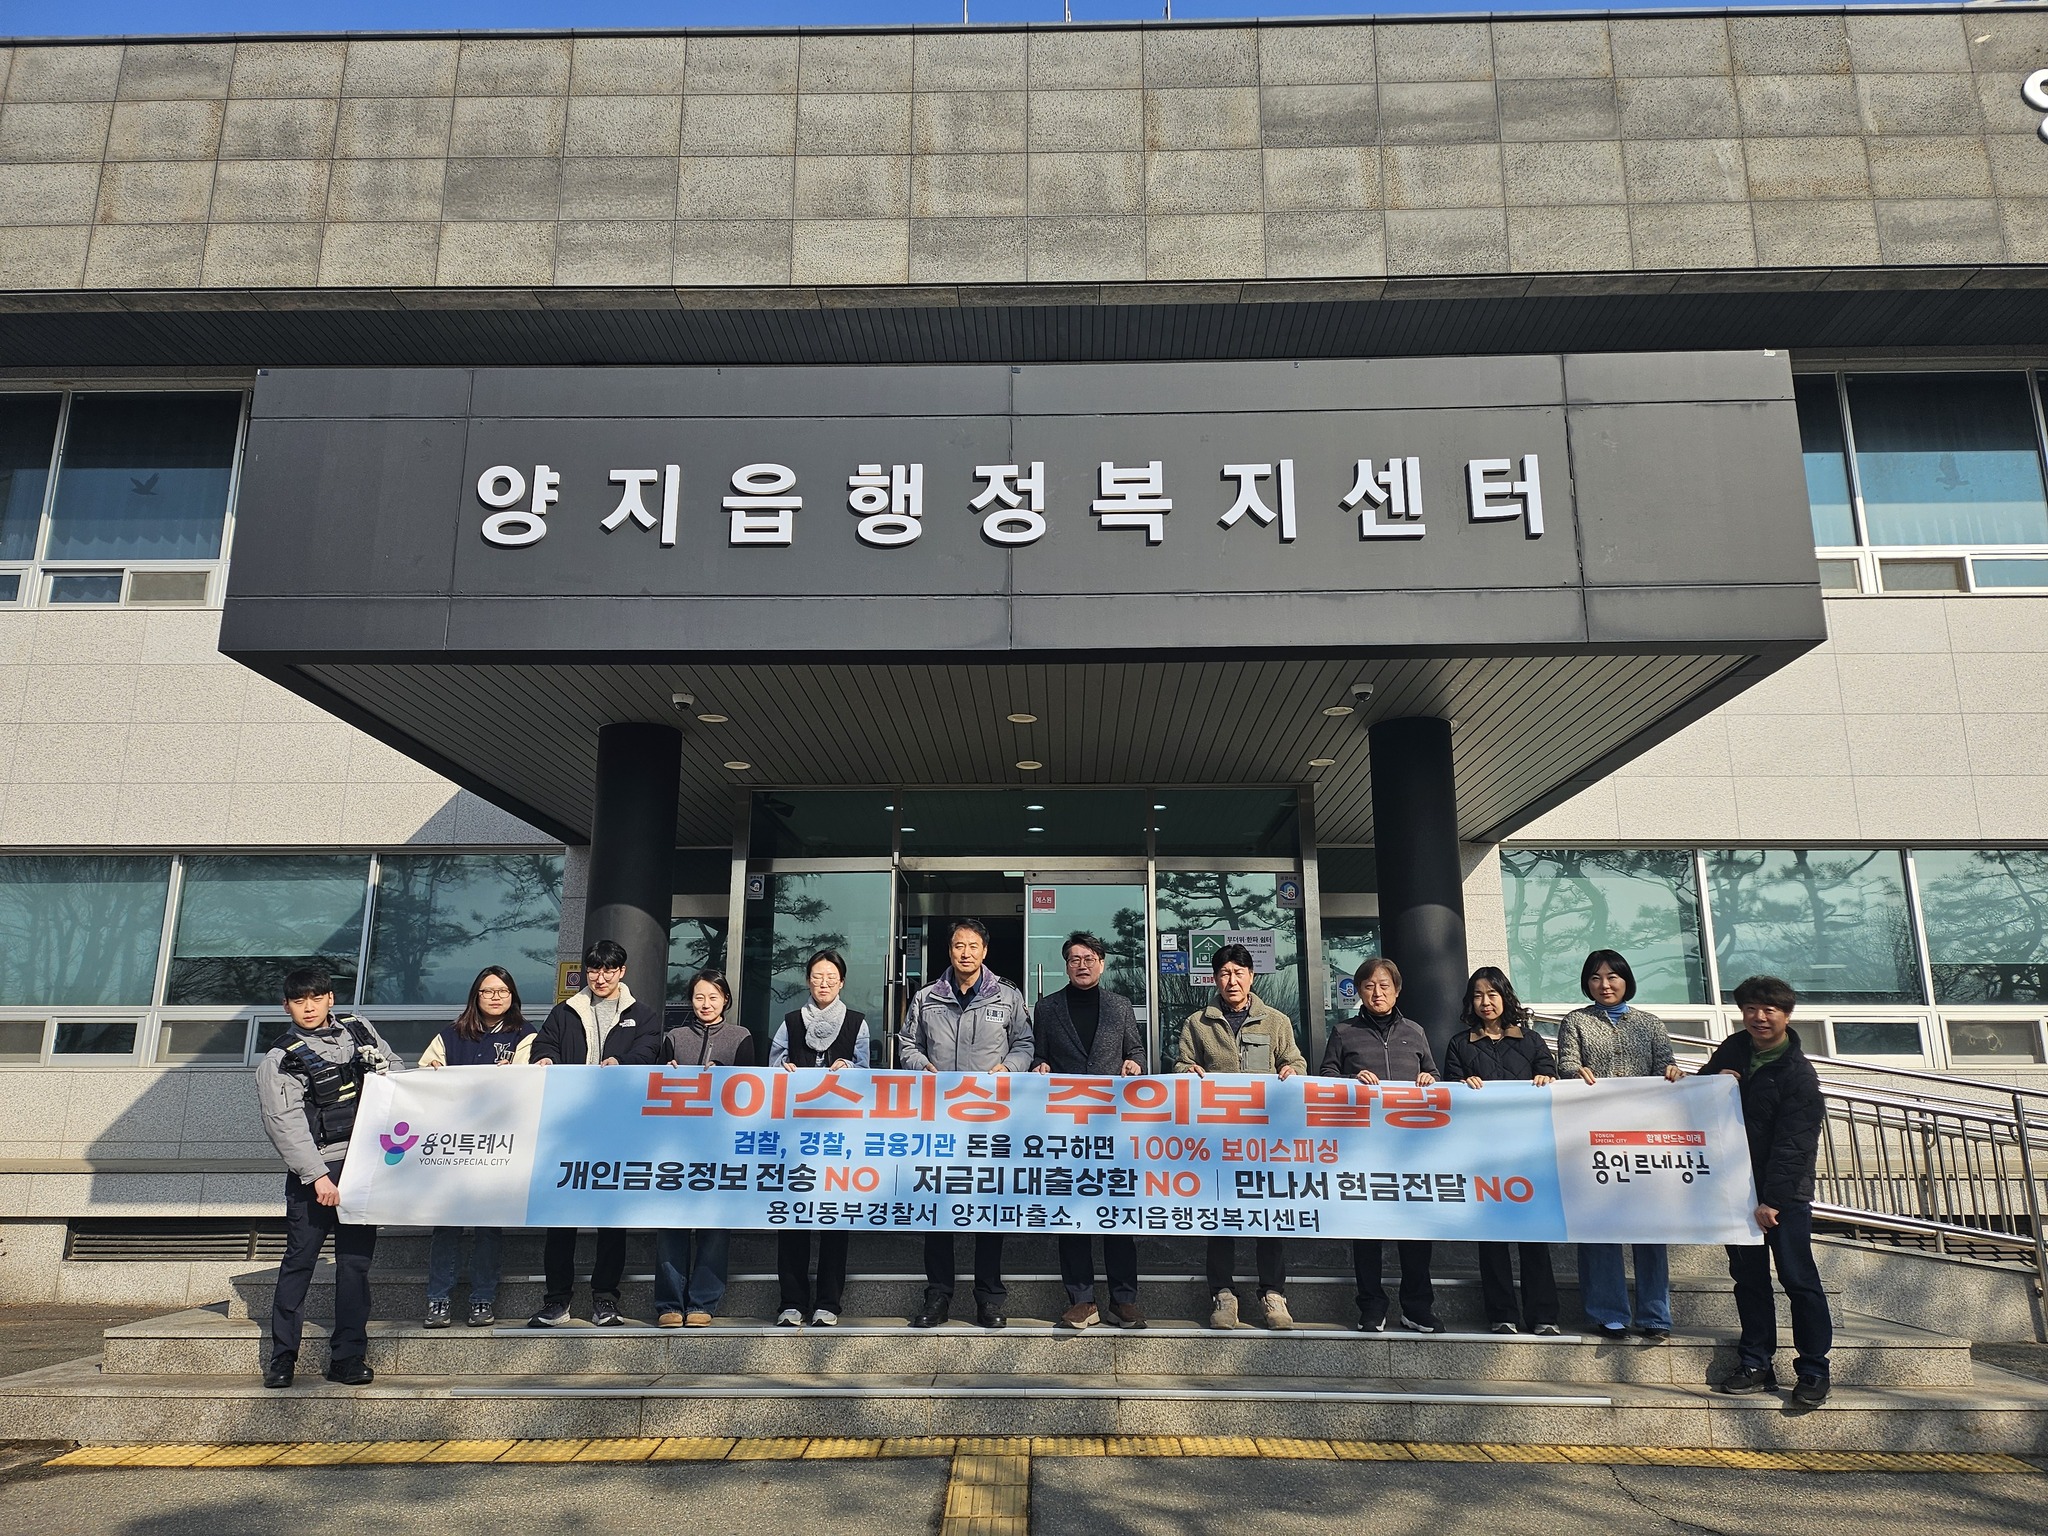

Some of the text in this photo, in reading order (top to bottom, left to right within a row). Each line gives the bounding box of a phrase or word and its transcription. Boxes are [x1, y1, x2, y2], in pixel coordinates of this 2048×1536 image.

[477, 454, 1545, 547] 양지읍행정복지센터
[641, 1072, 1452, 1129] 보이스피싱 주의보 발령
[420, 1132, 515, 1156] 용인특례시
[734, 1130, 1339, 1164] 검찰, 경찰, 금융기관 돈을 요구하면 100% 보이스피싱
[1662, 1134, 1685, 1143] 만드는
[1686, 1134, 1702, 1143] 미래
[419, 1157, 511, 1166] YONGIN SPECIAL CITY
[557, 1161, 880, 1192] 개인금융정보 전송 NO
[912, 1165, 1201, 1197] 저금리 대출상환 NO
[1235, 1170, 1535, 1203] 만나서 현금전달 NO
[766, 1200, 1320, 1232] 용인동부경찰서 양지파출소, 양지읍행정복지센터
